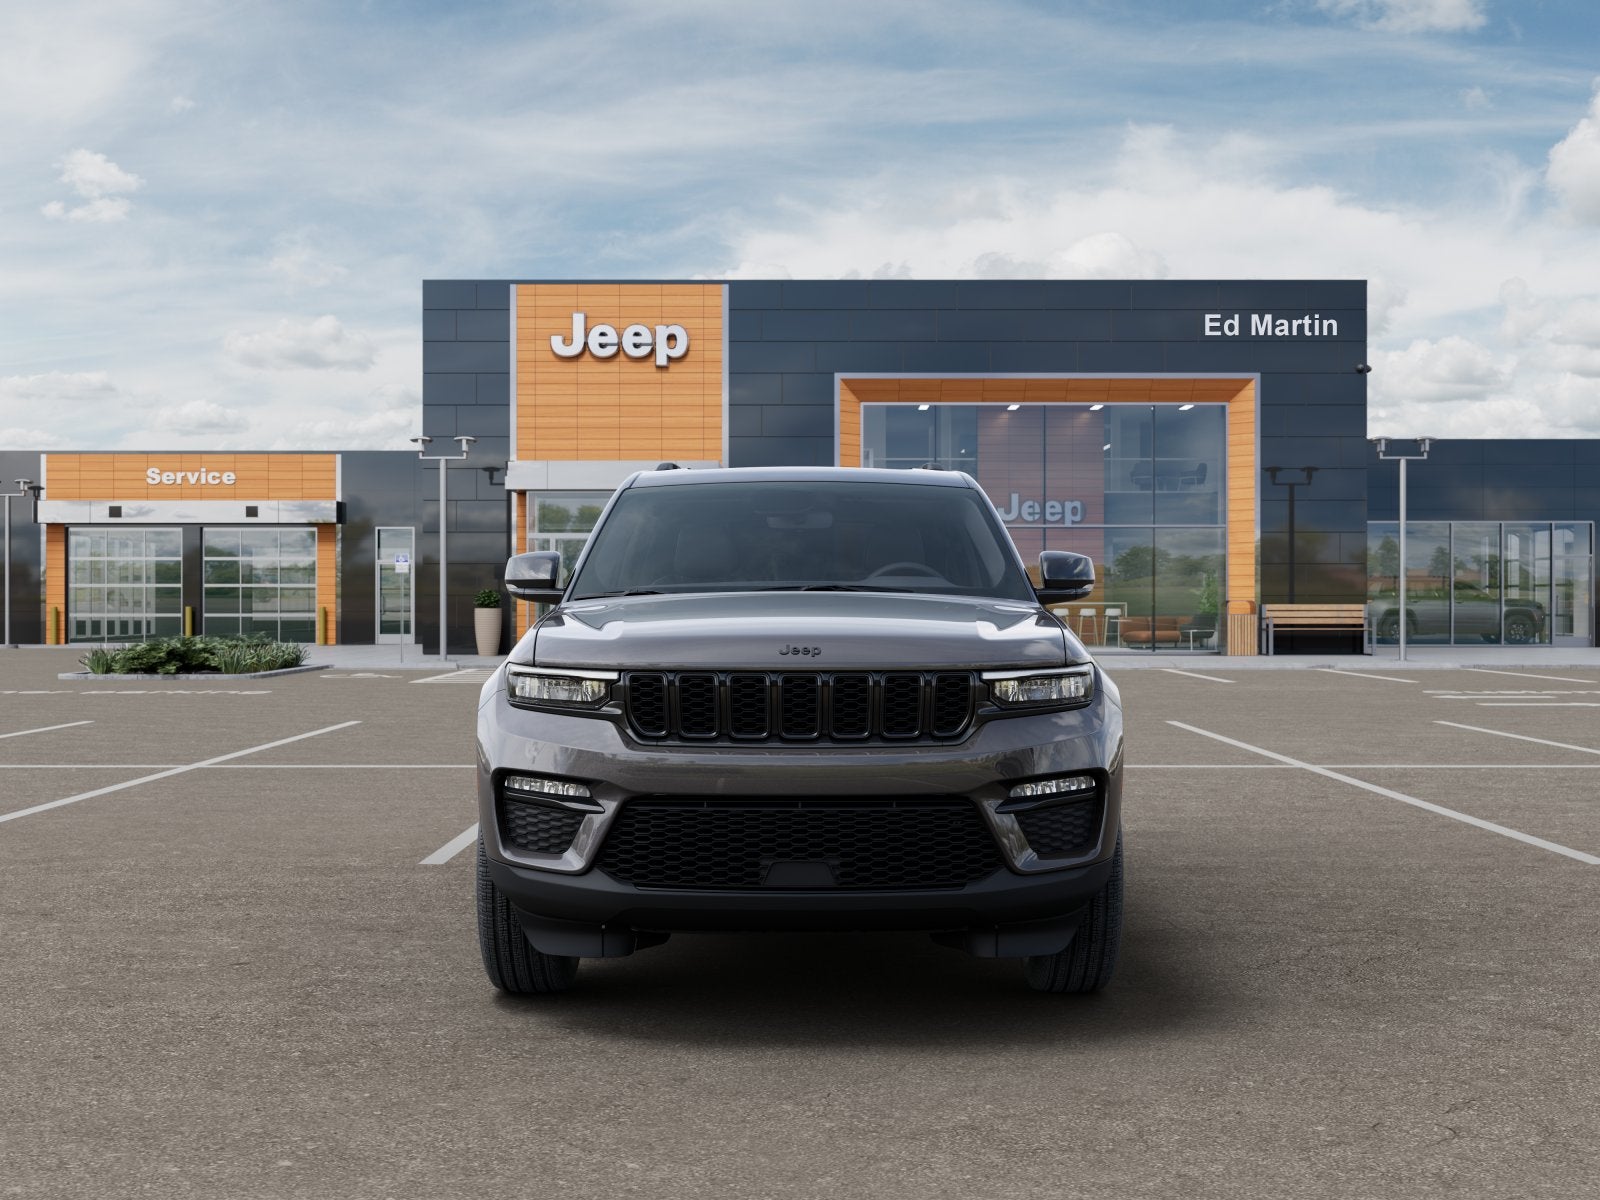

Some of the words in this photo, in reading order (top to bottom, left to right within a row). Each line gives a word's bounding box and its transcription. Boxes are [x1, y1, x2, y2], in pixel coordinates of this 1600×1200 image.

[1204, 313, 1240, 336] Ed
[1250, 313, 1338, 336] Martin
[550, 312, 689, 368] Jeep
[146, 467, 236, 485] Service
[997, 493, 1084, 526] Jeep
[778, 644, 822, 658] Jeep
